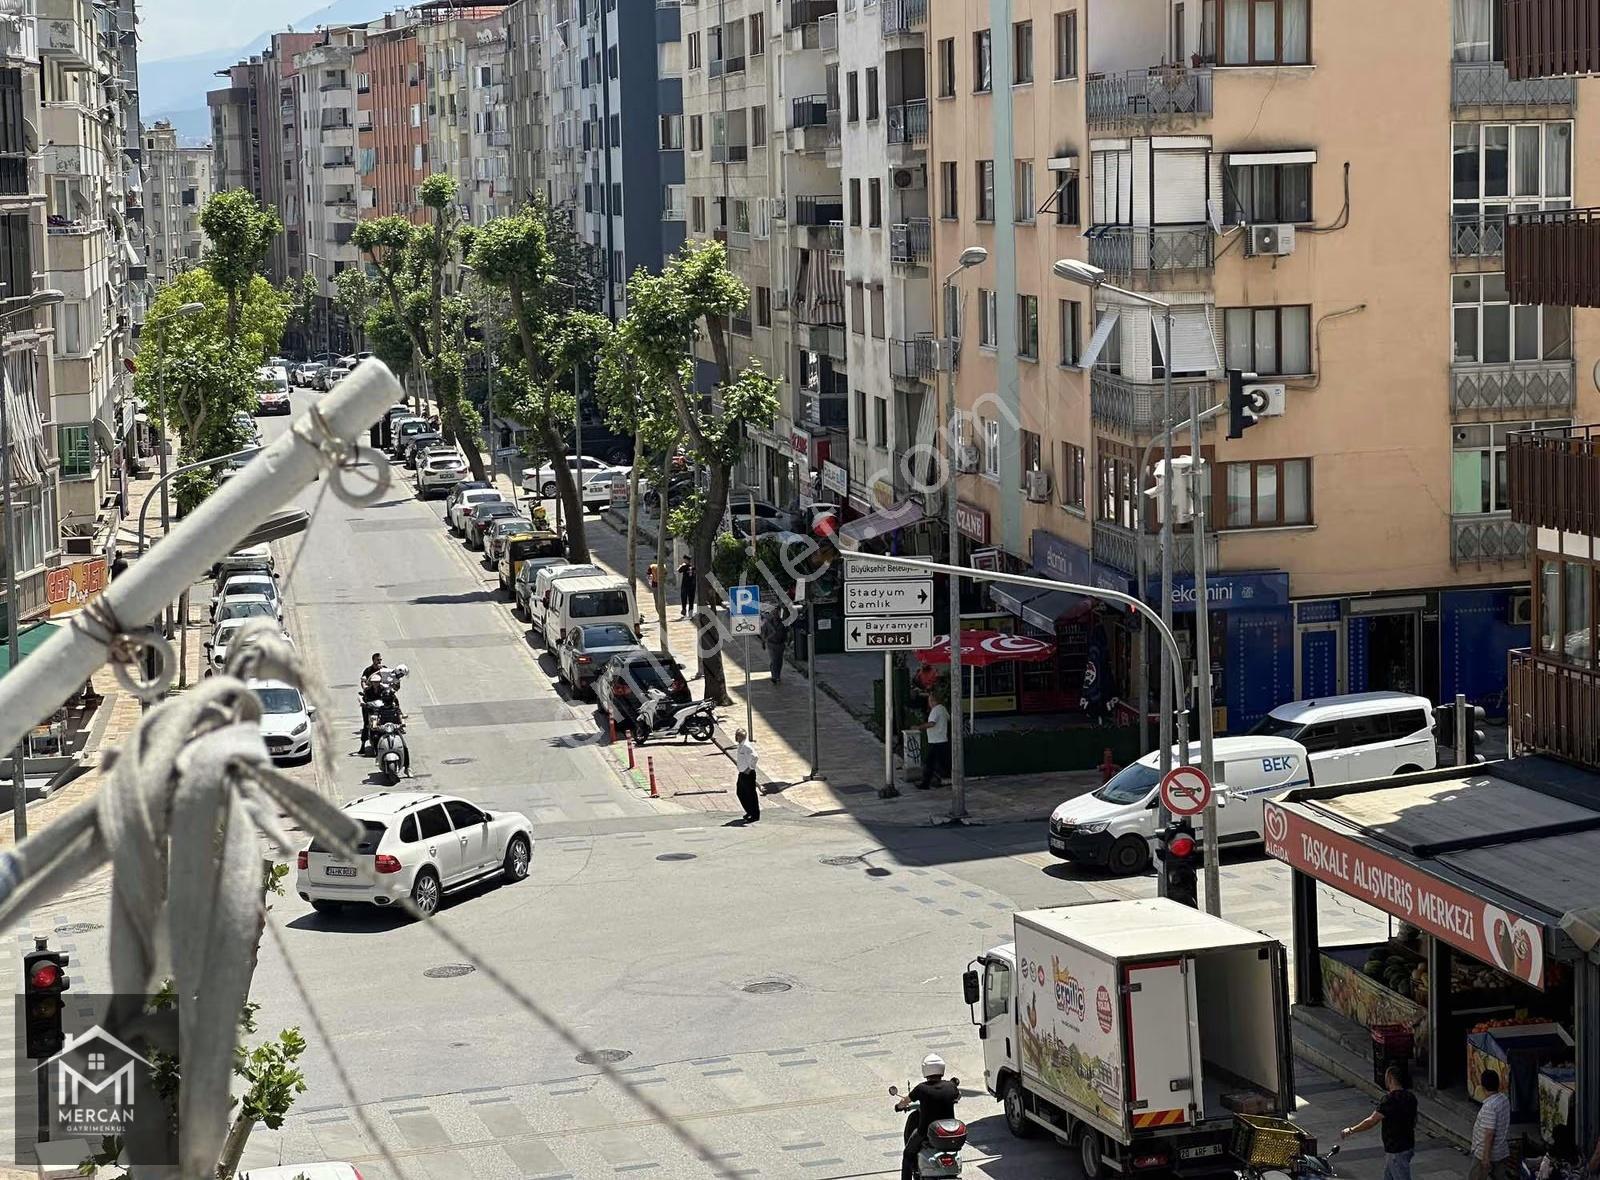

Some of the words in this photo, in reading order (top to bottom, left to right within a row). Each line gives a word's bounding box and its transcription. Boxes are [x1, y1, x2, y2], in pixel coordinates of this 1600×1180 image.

[956, 510, 982, 537] CZANE
[849, 588, 905, 599] Stadyum
[865, 621, 928, 631] Bayramyeri
[868, 634, 909, 644] Kaleiçi
[1262, 756, 1292, 772] BEK
[1300, 833, 1350, 880] TAŞKALE
[1417, 888, 1474, 942] MERKEZİ
